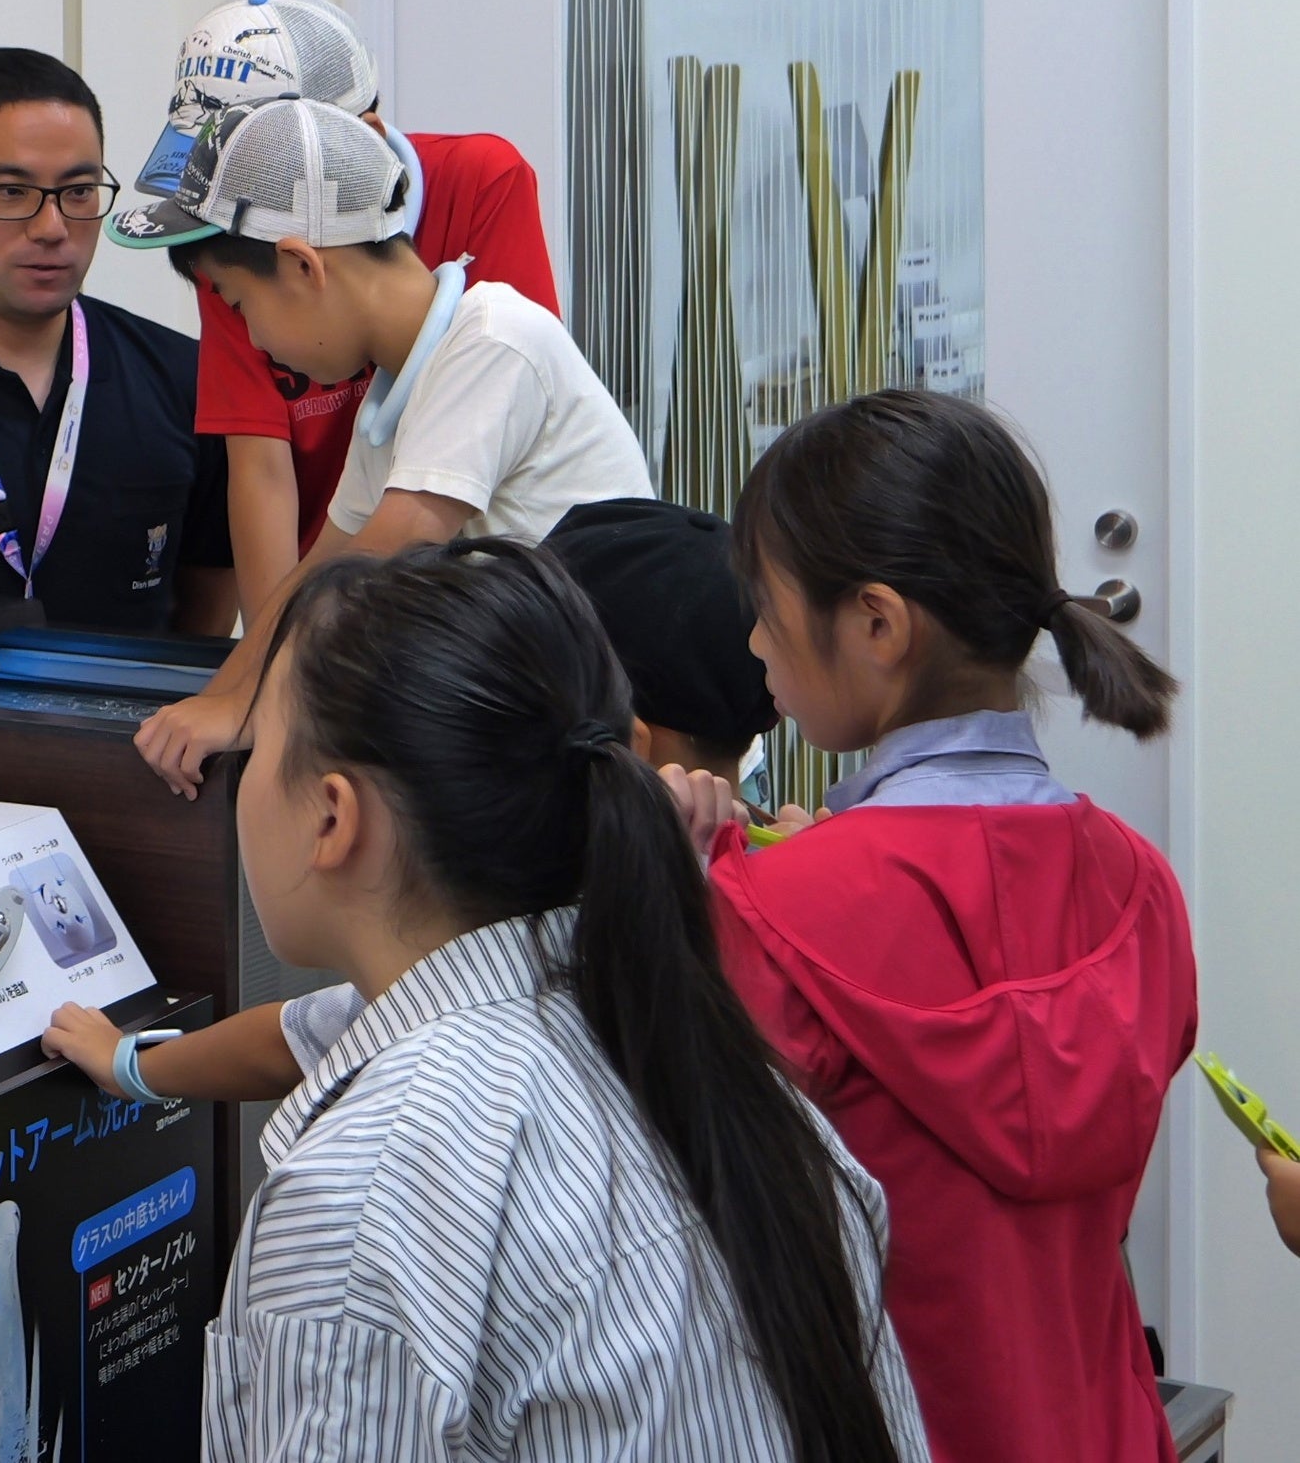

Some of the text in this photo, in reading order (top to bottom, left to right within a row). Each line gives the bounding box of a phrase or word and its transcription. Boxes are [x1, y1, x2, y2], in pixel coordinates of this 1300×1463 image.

[223, 45, 252, 60] Cherish
[255, 55, 271, 67] this
[293, 390, 351, 422] HEALTHY
[78, 1177, 189, 1263] グラスの中底もキレイ
[89, 1230, 196, 1305] NEW センターノズル
